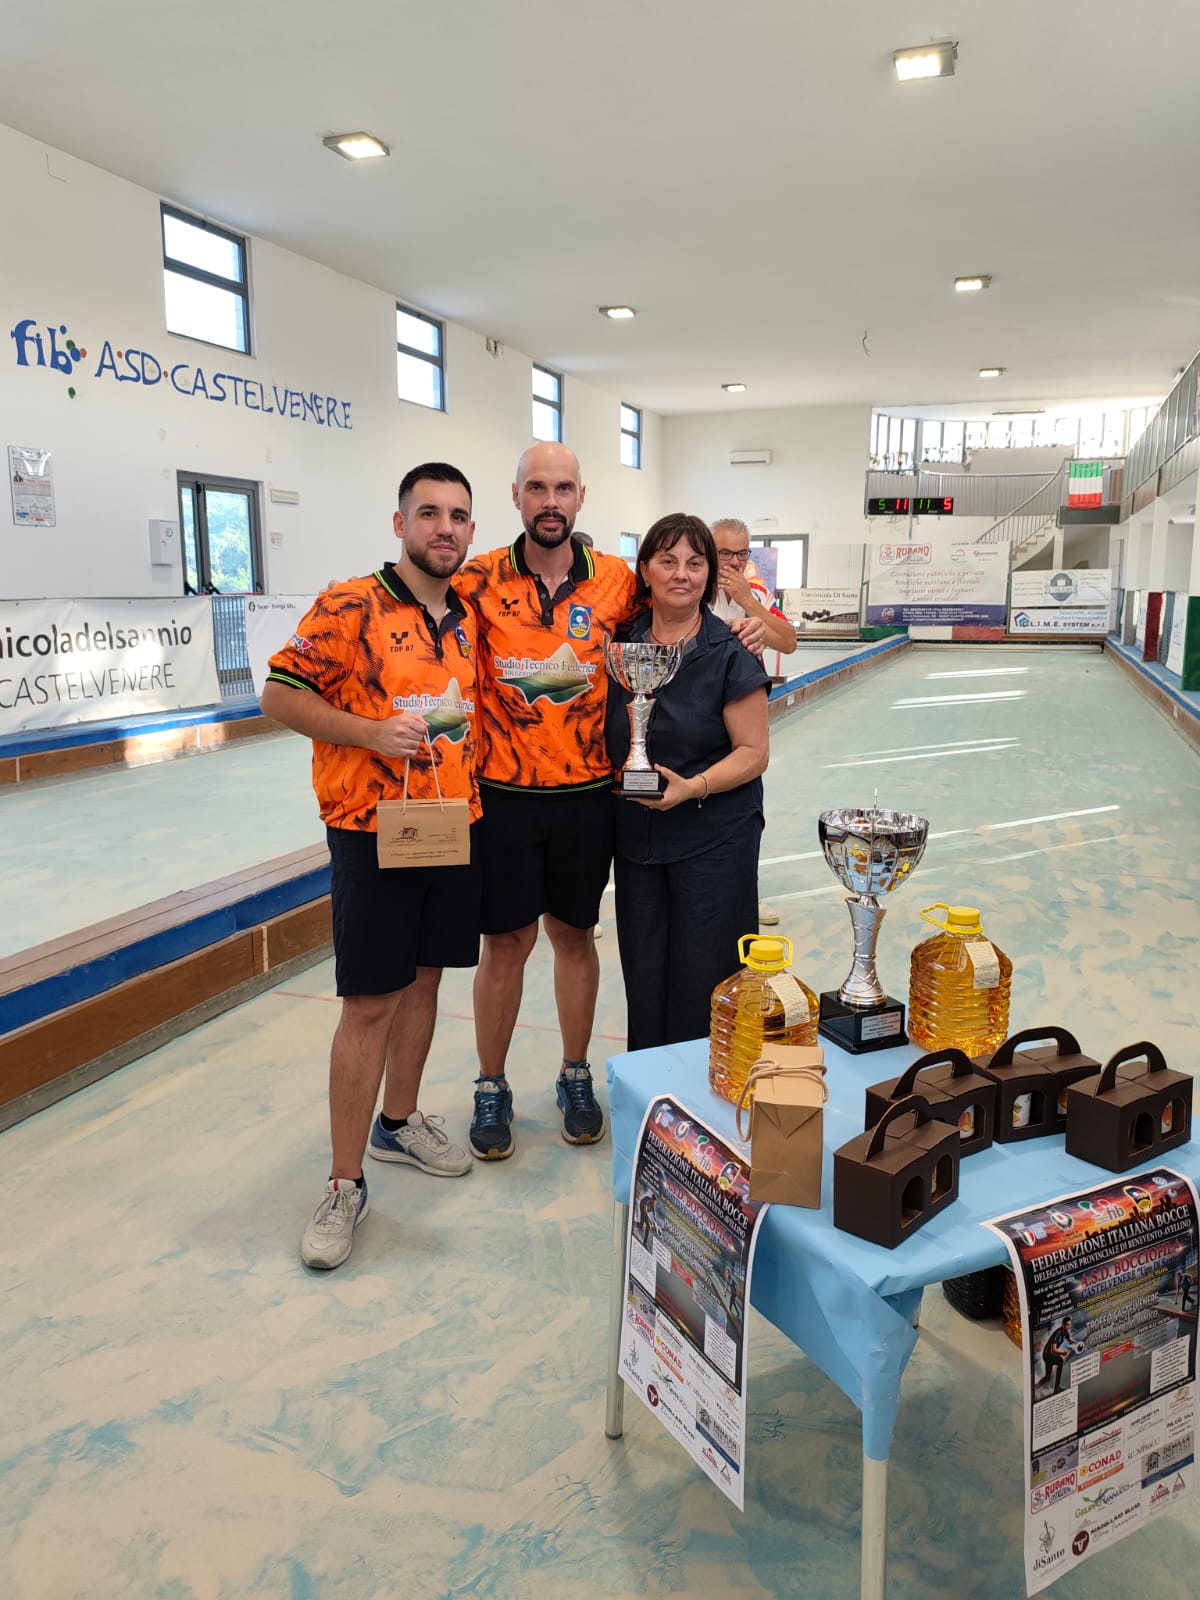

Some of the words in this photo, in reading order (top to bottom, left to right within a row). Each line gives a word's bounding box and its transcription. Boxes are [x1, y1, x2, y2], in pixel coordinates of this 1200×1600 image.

[11, 319, 72, 375] fib
[878, 499, 886, 510] 5
[896, 498, 907, 510] 11
[920, 498, 931, 510] 11
[944, 498, 952, 510] 5
[896, 545, 930, 559] RUBANO
[0, 619, 192, 659] icoladelsannio
[494, 657, 521, 670] Studio
[524, 659, 559, 671] Tecnico
[561, 660, 597, 674] Federico
[393, 696, 420, 709] Studio
[648, 1130, 691, 1176] FEDERAZIONE
[689, 1171, 722, 1207] ITALIANA
[722, 1198, 749, 1230] BOCCE
[1107, 1205, 1124, 1220] fib
[1031, 1233, 1106, 1273] FEDERAZIONE
[1107, 1216, 1155, 1246] ITALIANA
[1155, 1204, 1190, 1228] BOCCE
[1033, 1260, 1079, 1284] DELEGAZIONE
[1079, 1245, 1120, 1267] PROVINCIALE
[1081, 1265, 1112, 1288] A.S.D.
[1113, 1237, 1182, 1277] BOCCIOFILA
[1081, 1270, 1136, 1299] CASTELVENERE
[1088, 1450, 1121, 1473] CONAD
[1044, 1473, 1075, 1500] RUBANO
[1033, 1549, 1065, 1571] diSanto
